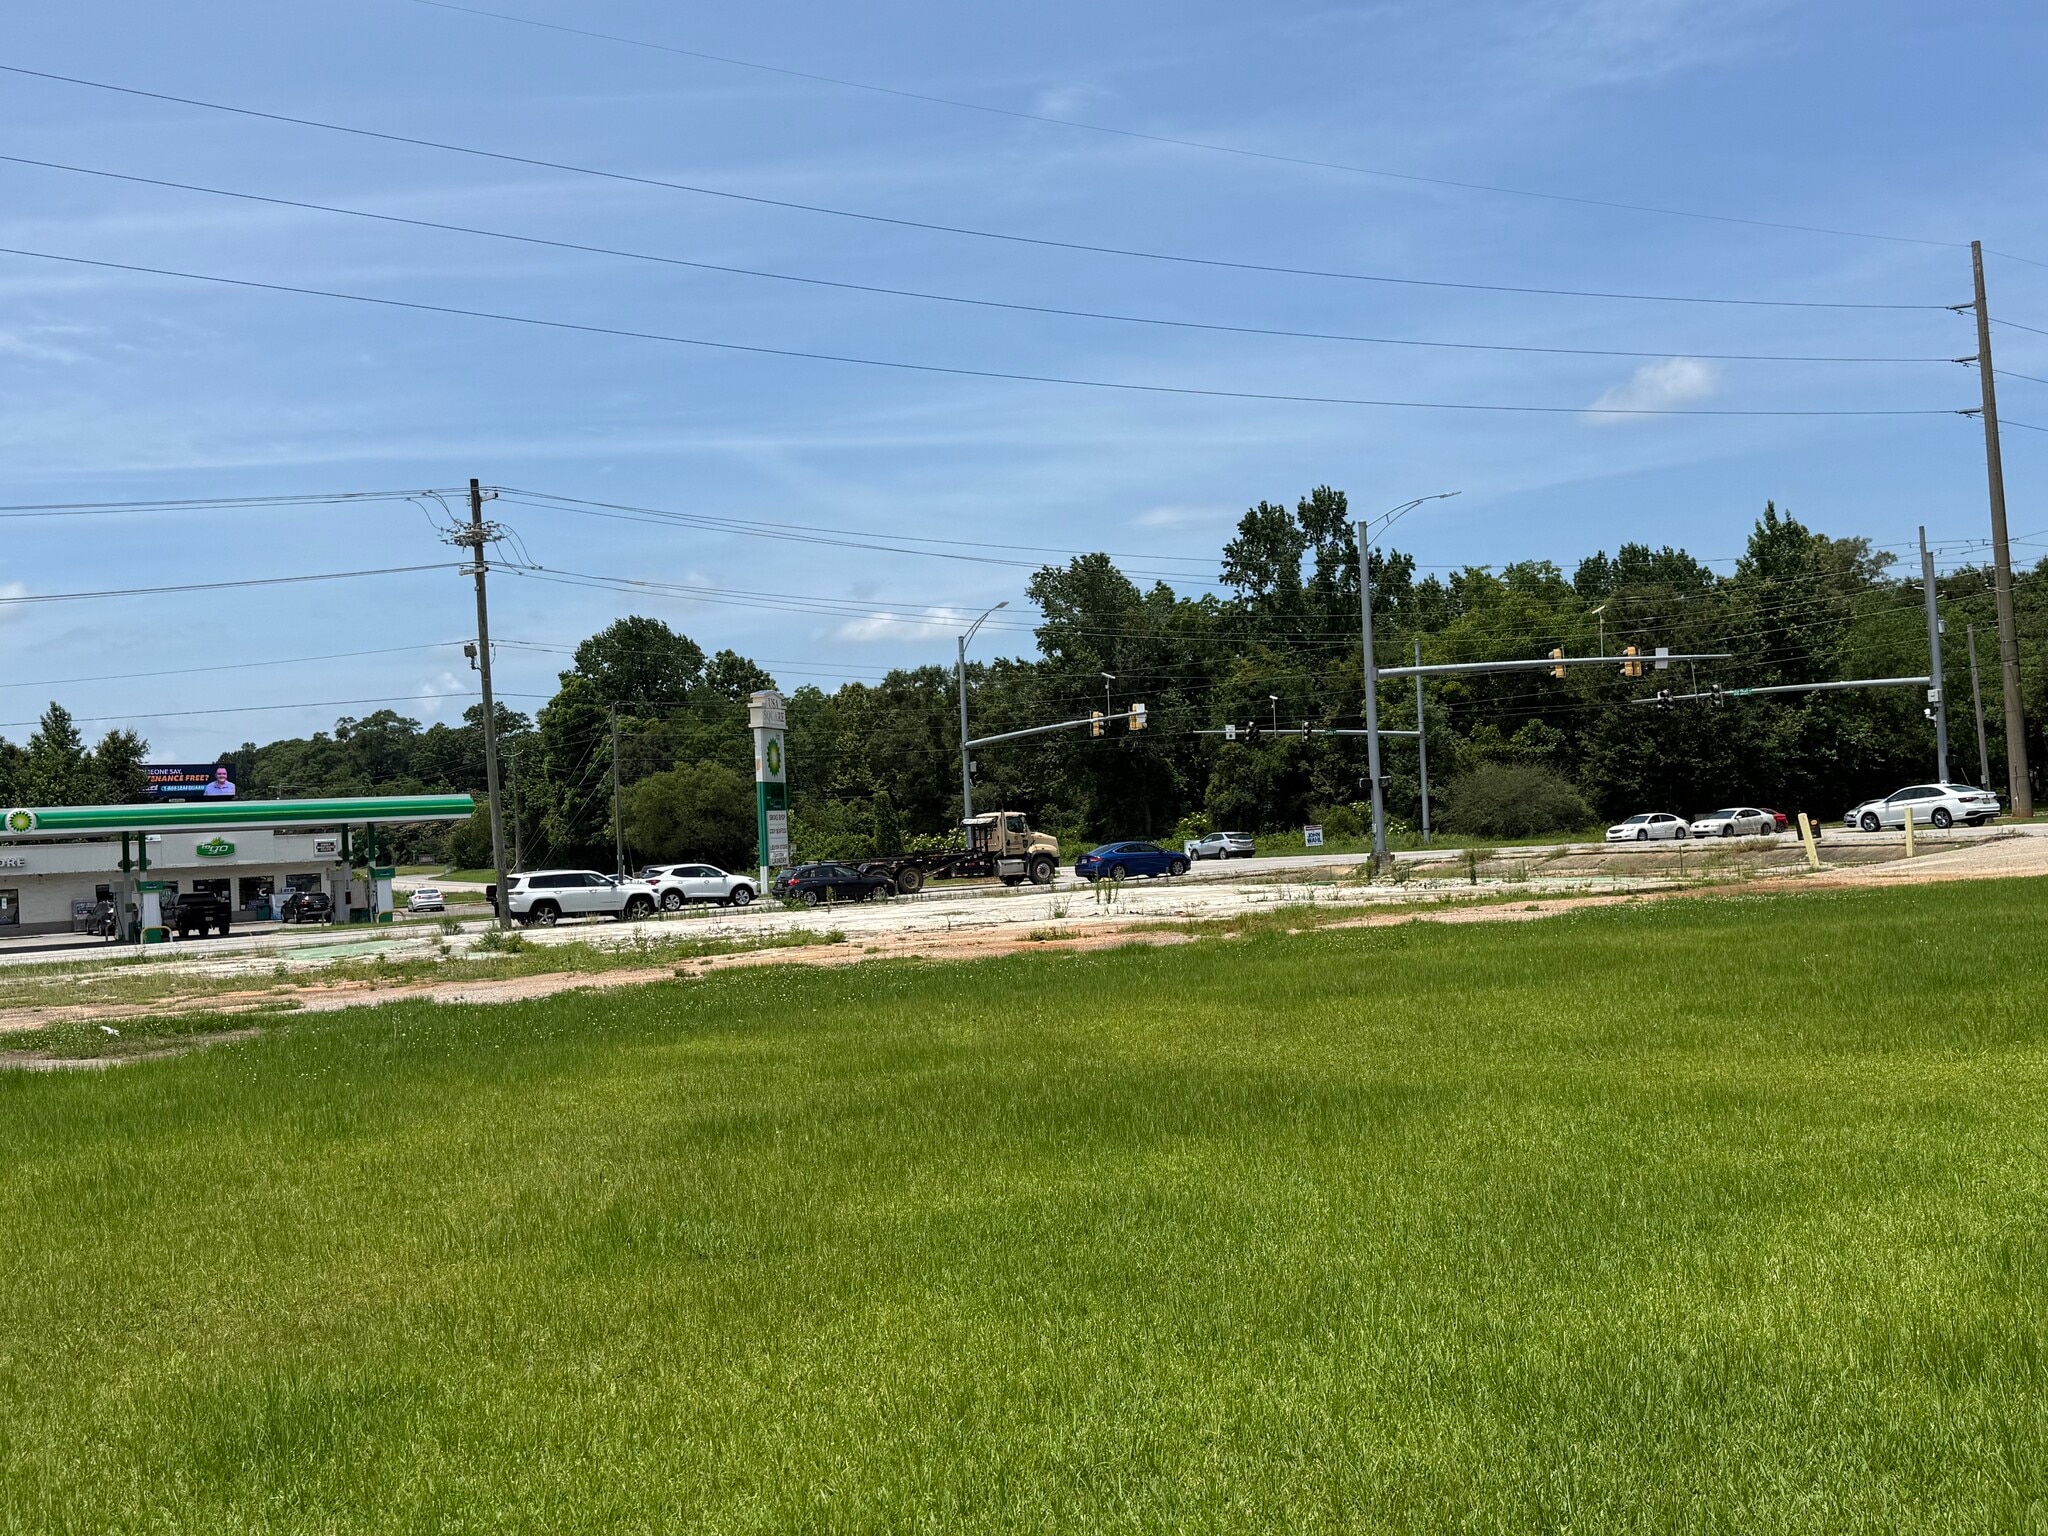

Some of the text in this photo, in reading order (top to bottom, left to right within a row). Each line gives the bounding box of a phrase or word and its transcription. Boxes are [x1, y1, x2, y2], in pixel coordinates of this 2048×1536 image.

[768, 697, 779, 709] USA
[763, 709, 785, 723] SQUARE
[185, 774, 210, 782] FREE?
[208, 845, 229, 855] go
